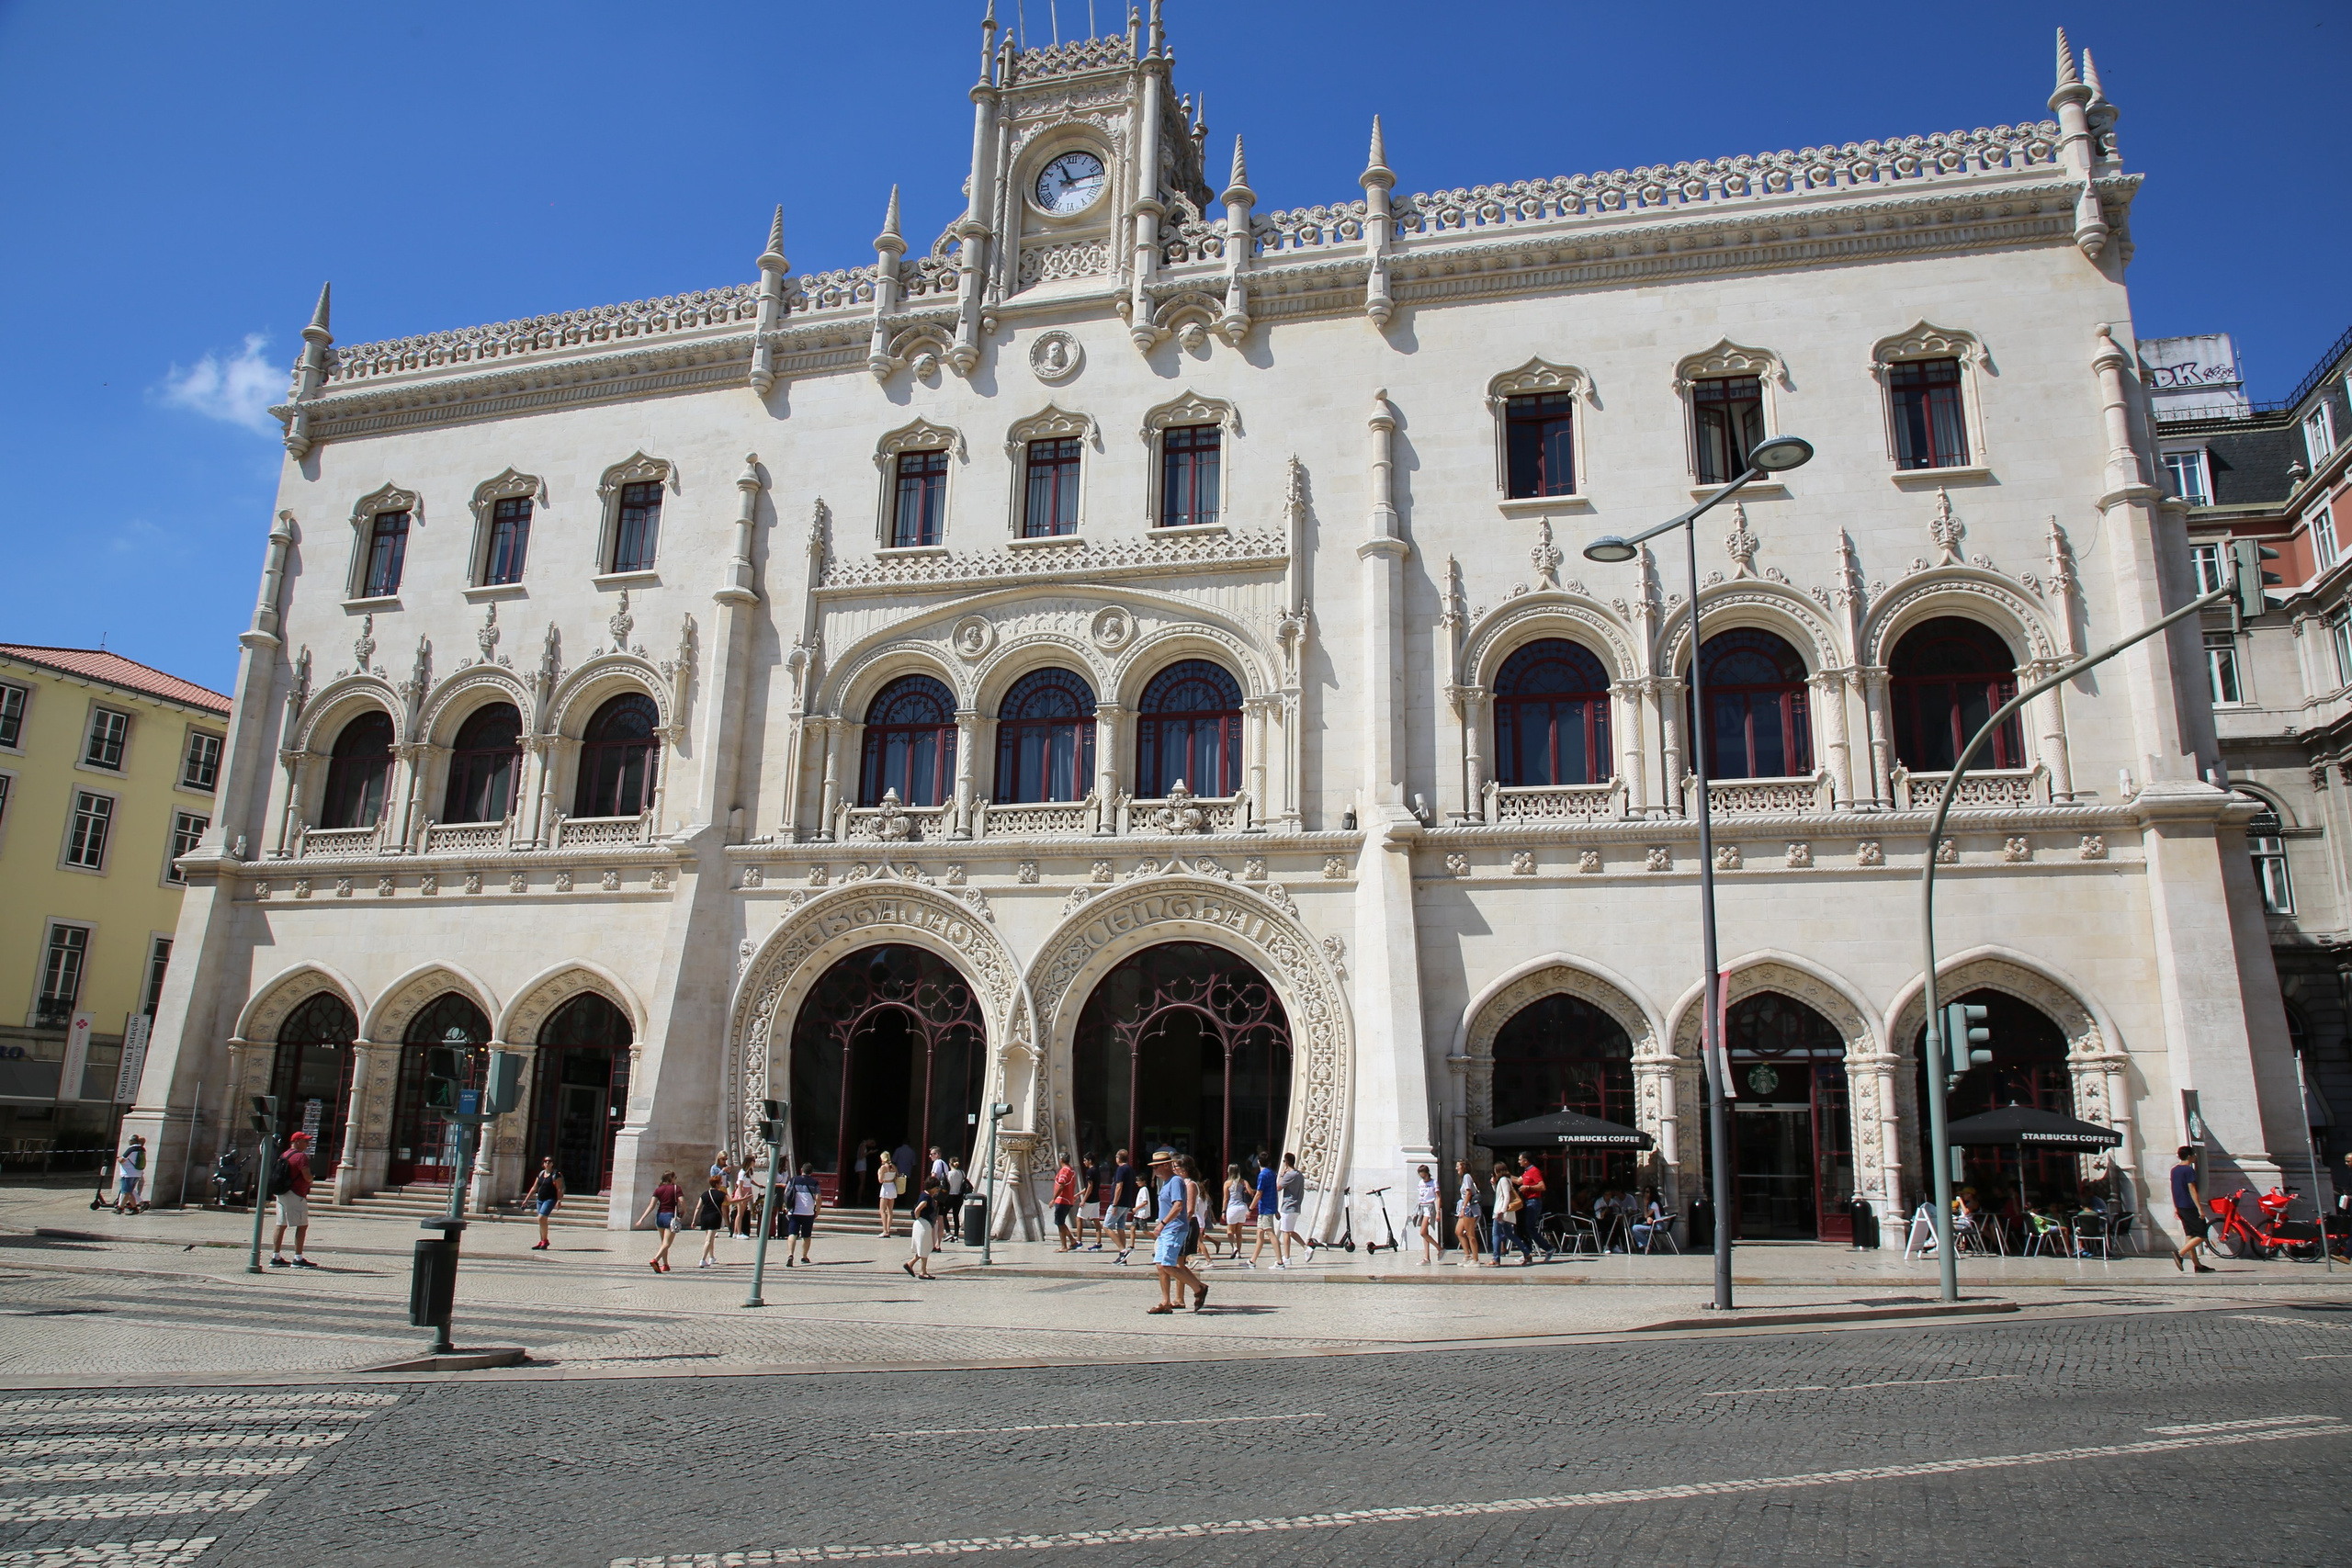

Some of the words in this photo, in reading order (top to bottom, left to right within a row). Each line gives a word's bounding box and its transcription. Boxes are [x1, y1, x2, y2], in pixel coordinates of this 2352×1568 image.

[126, 1017, 140, 1051] Estação
[125, 1052, 132, 1063] da
[128, 1056, 141, 1095] Restaurant
[136, 1022, 147, 1049] Terrace
[118, 1064, 130, 1100] Cozinha
[2021, 1133, 2077, 1142] STARBUCKS
[2079, 1134, 2116, 1144] COFFEE
